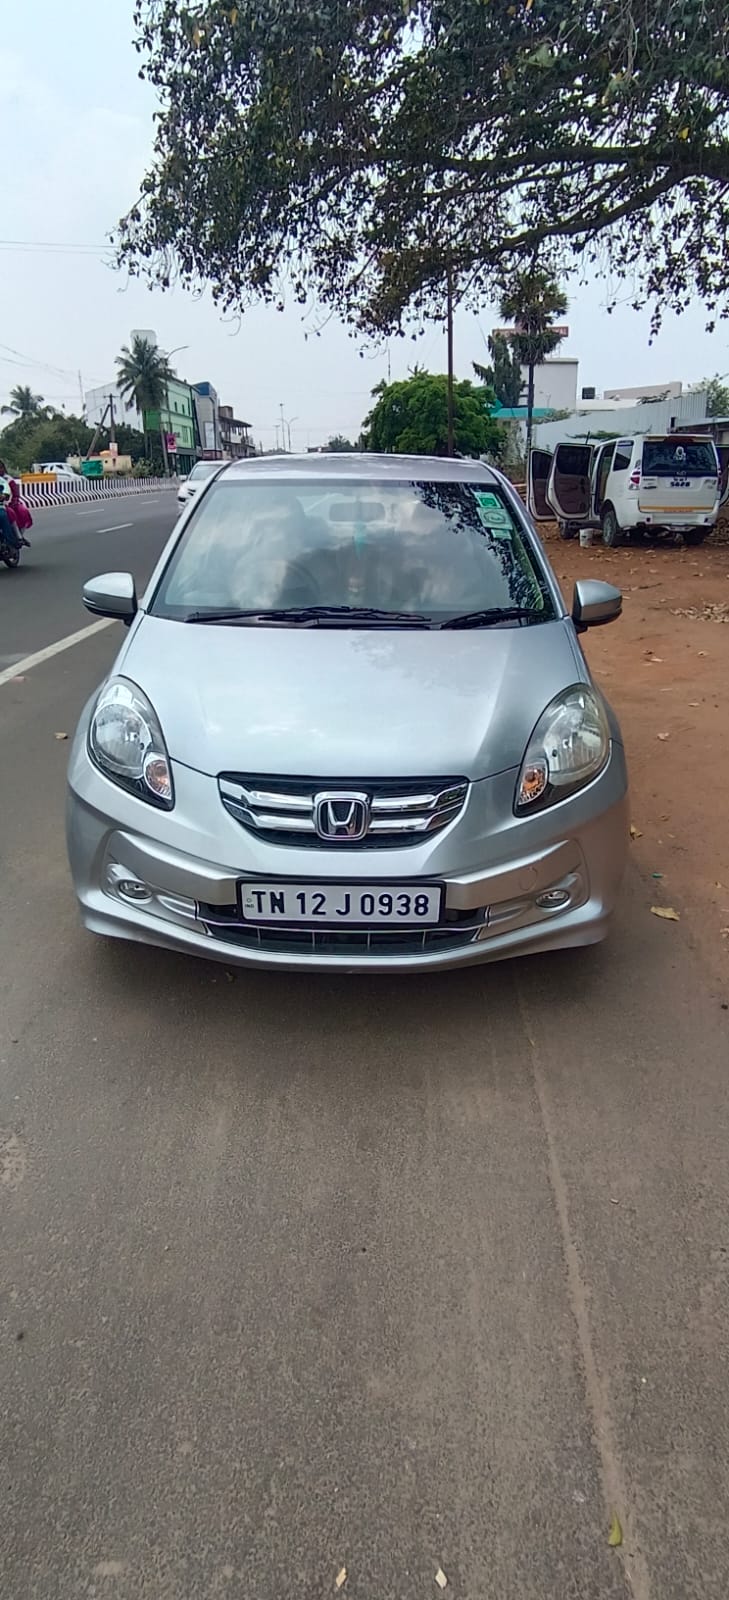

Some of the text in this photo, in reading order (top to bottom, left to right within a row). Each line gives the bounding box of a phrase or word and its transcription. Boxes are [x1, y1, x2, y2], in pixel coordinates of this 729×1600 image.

[251, 890, 429, 917] TN 12 J 0938
